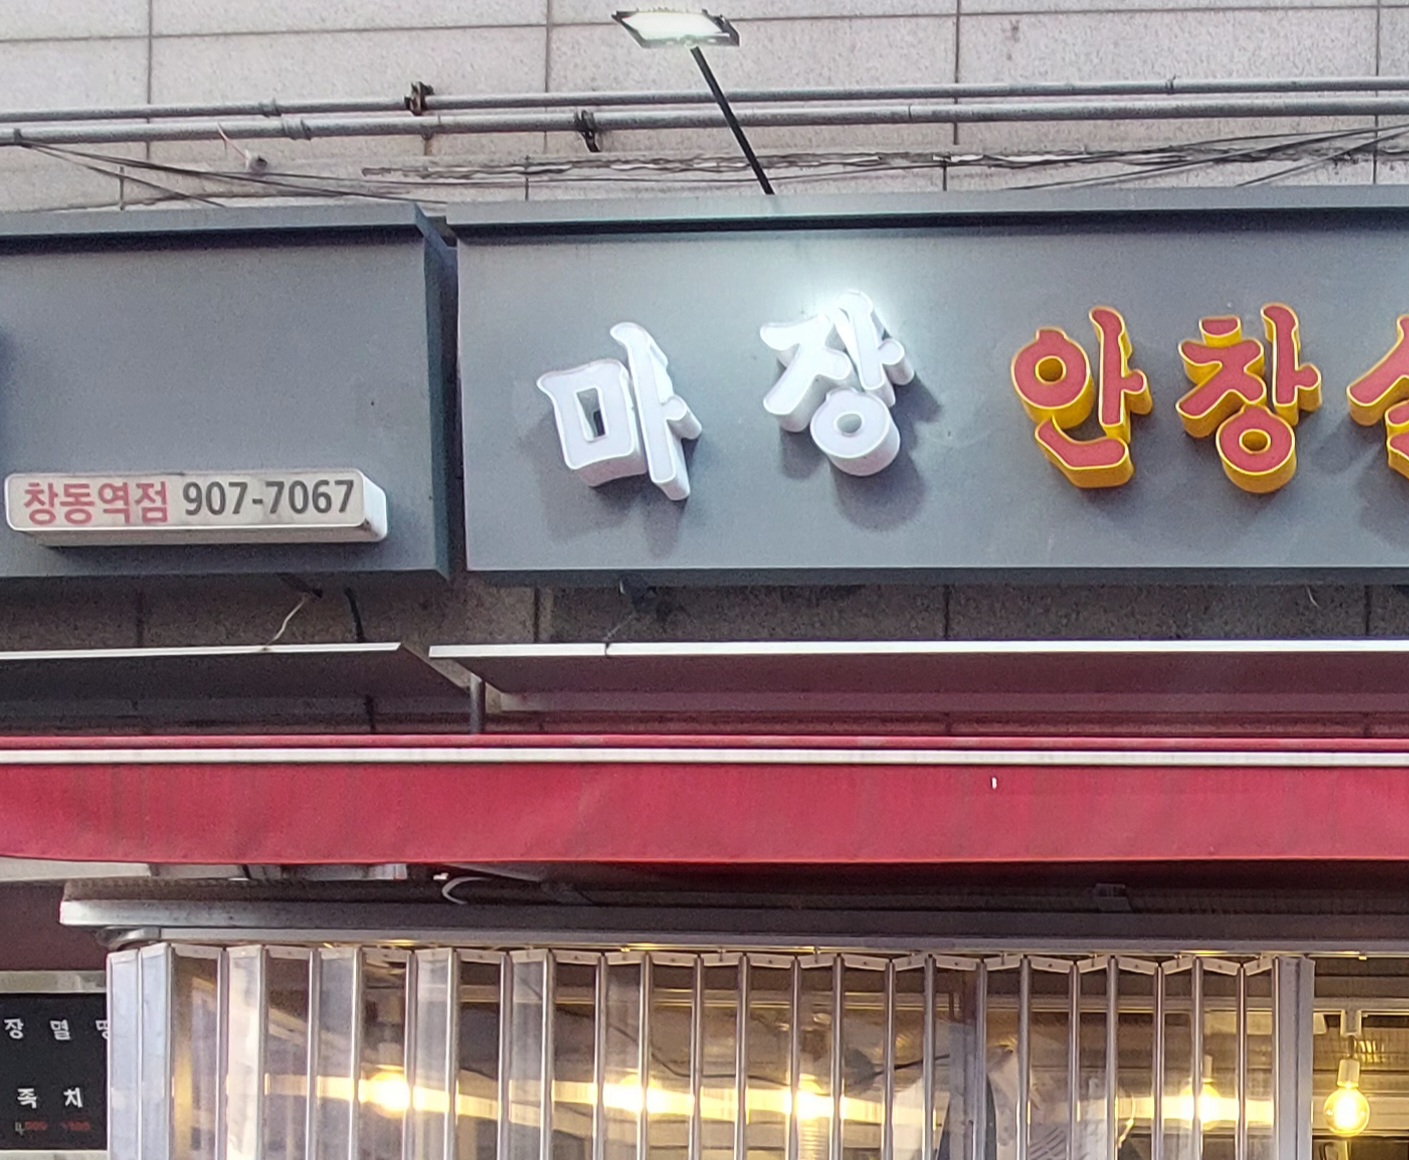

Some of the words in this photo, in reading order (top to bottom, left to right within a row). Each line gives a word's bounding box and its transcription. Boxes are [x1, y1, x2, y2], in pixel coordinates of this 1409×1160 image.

[537, 290, 913, 500] 마장
[23, 480, 170, 526] 창동역점
[182, 478, 355, 516] 907-7067
